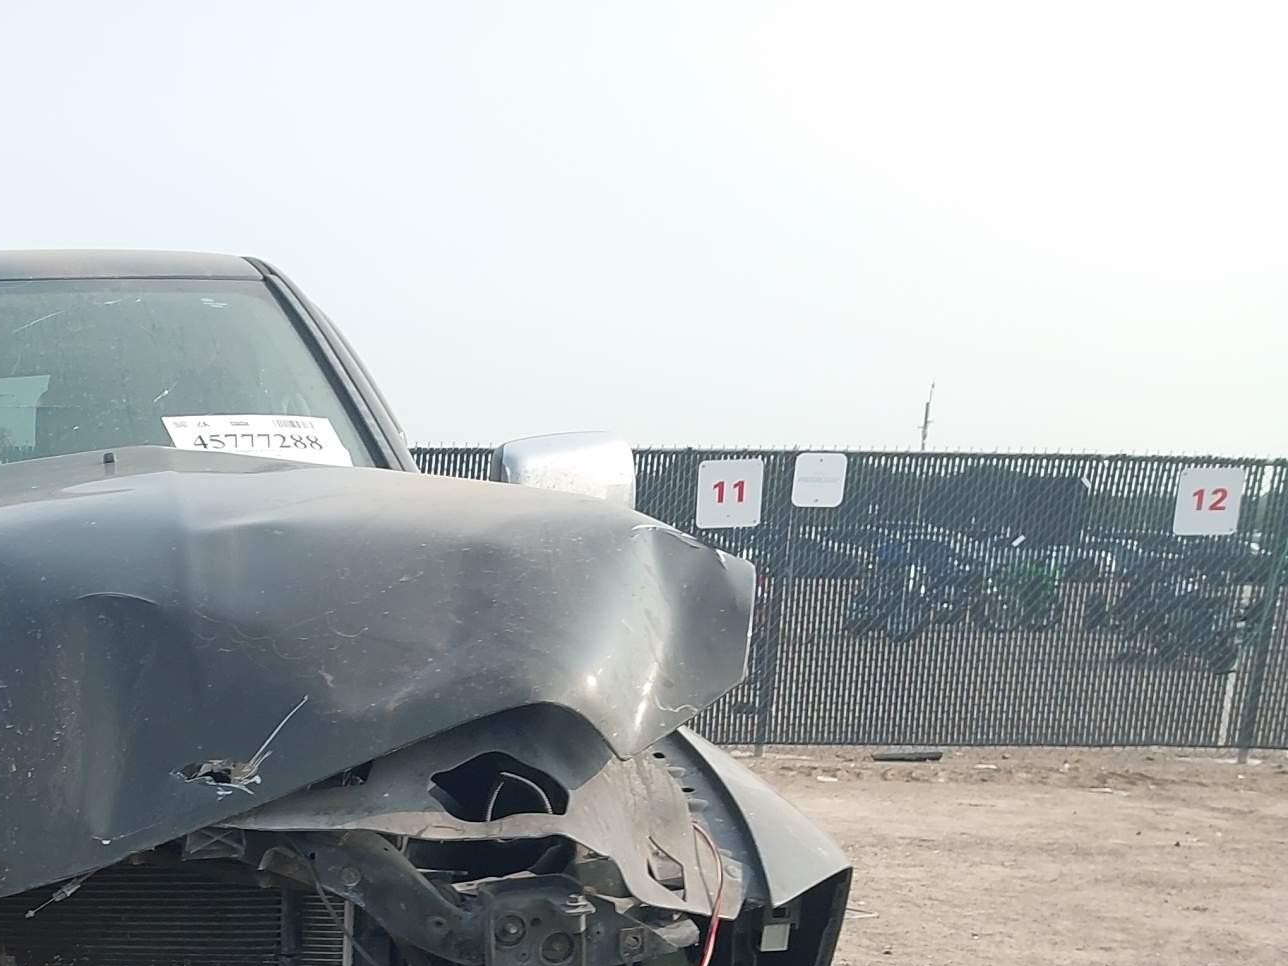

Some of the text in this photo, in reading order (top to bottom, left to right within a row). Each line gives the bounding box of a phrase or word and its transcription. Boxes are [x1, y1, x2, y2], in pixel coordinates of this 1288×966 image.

[193, 433, 324, 450] 45777288
[712, 480, 746, 504] 11
[1192, 488, 1228, 511] 12
